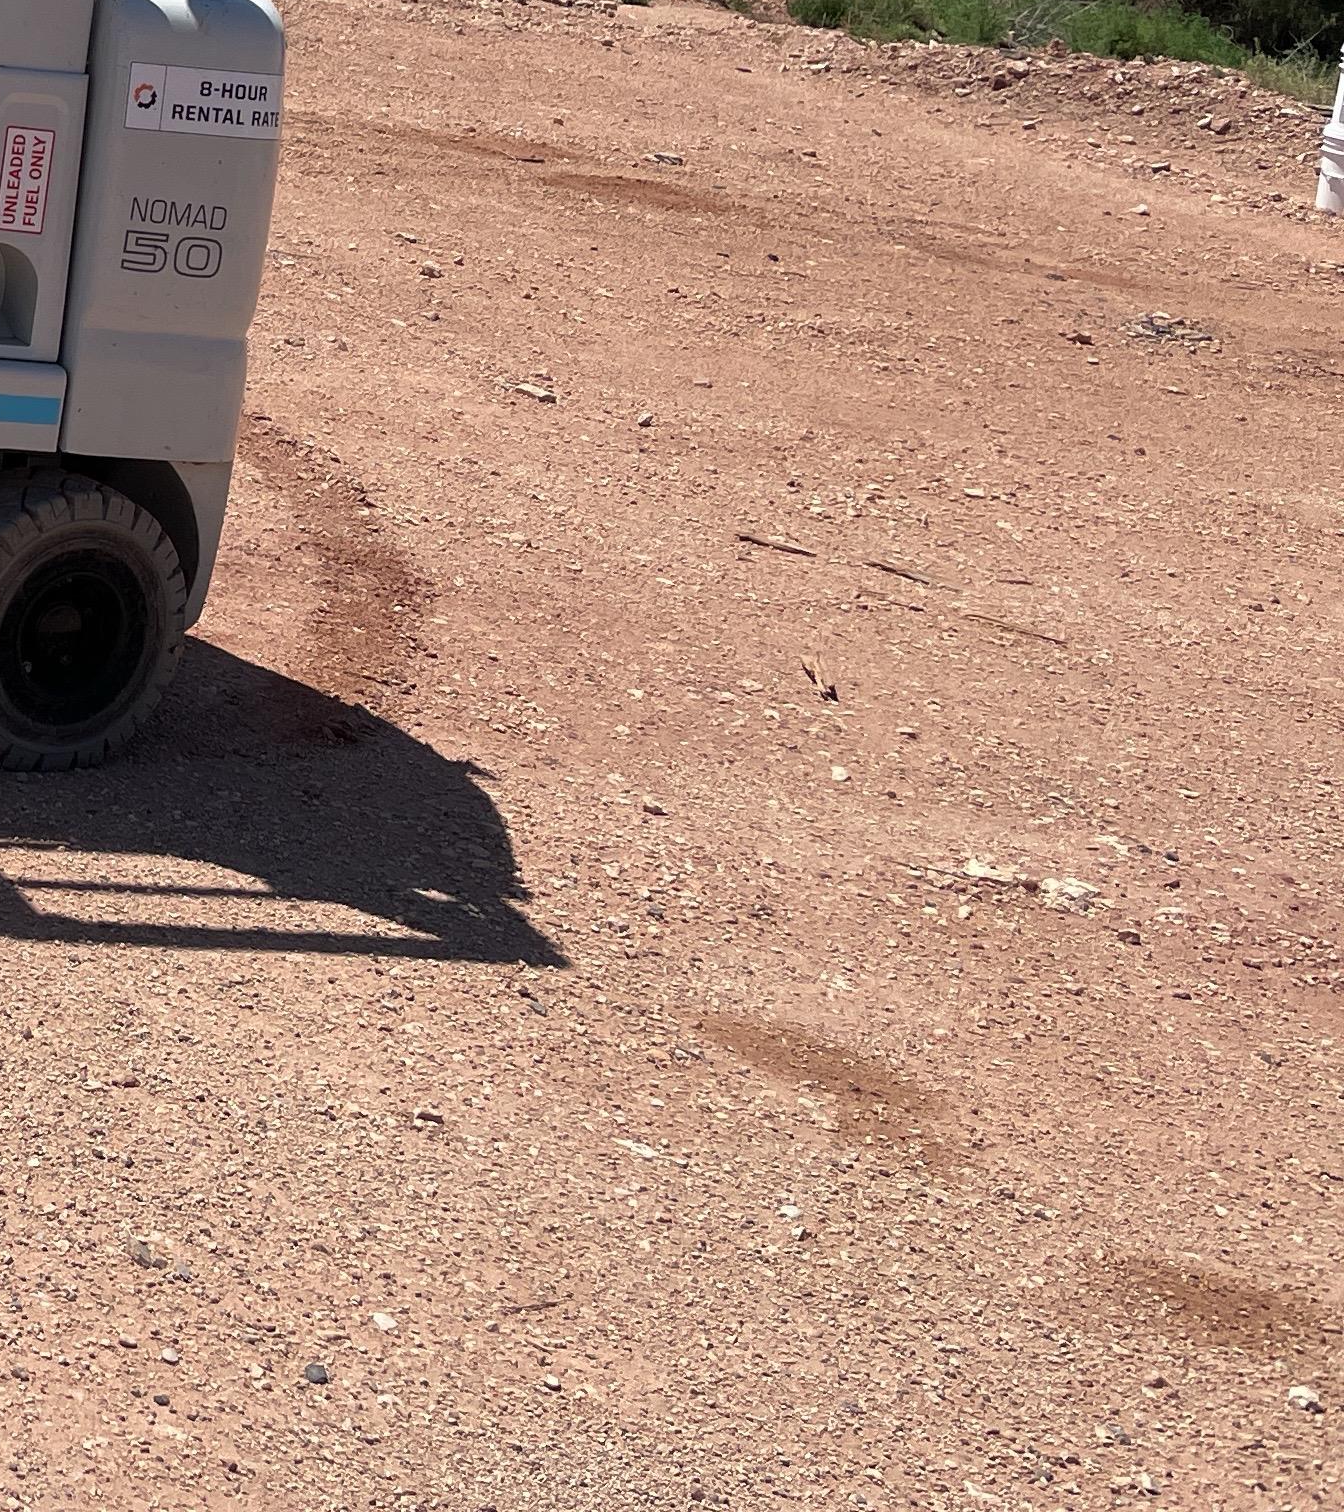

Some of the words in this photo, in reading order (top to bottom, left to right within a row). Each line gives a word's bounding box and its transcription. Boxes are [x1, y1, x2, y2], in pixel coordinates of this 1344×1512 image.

[199, 80, 268, 102] 8-HOUR
[171, 103, 245, 126] RENTAL
[29, 135, 47, 180] ONLY
[2, 134, 26, 224] UNLEADED
[22, 185, 41, 227] FUEL
[130, 196, 228, 231] NOMAD
[120, 229, 223, 279] 50
